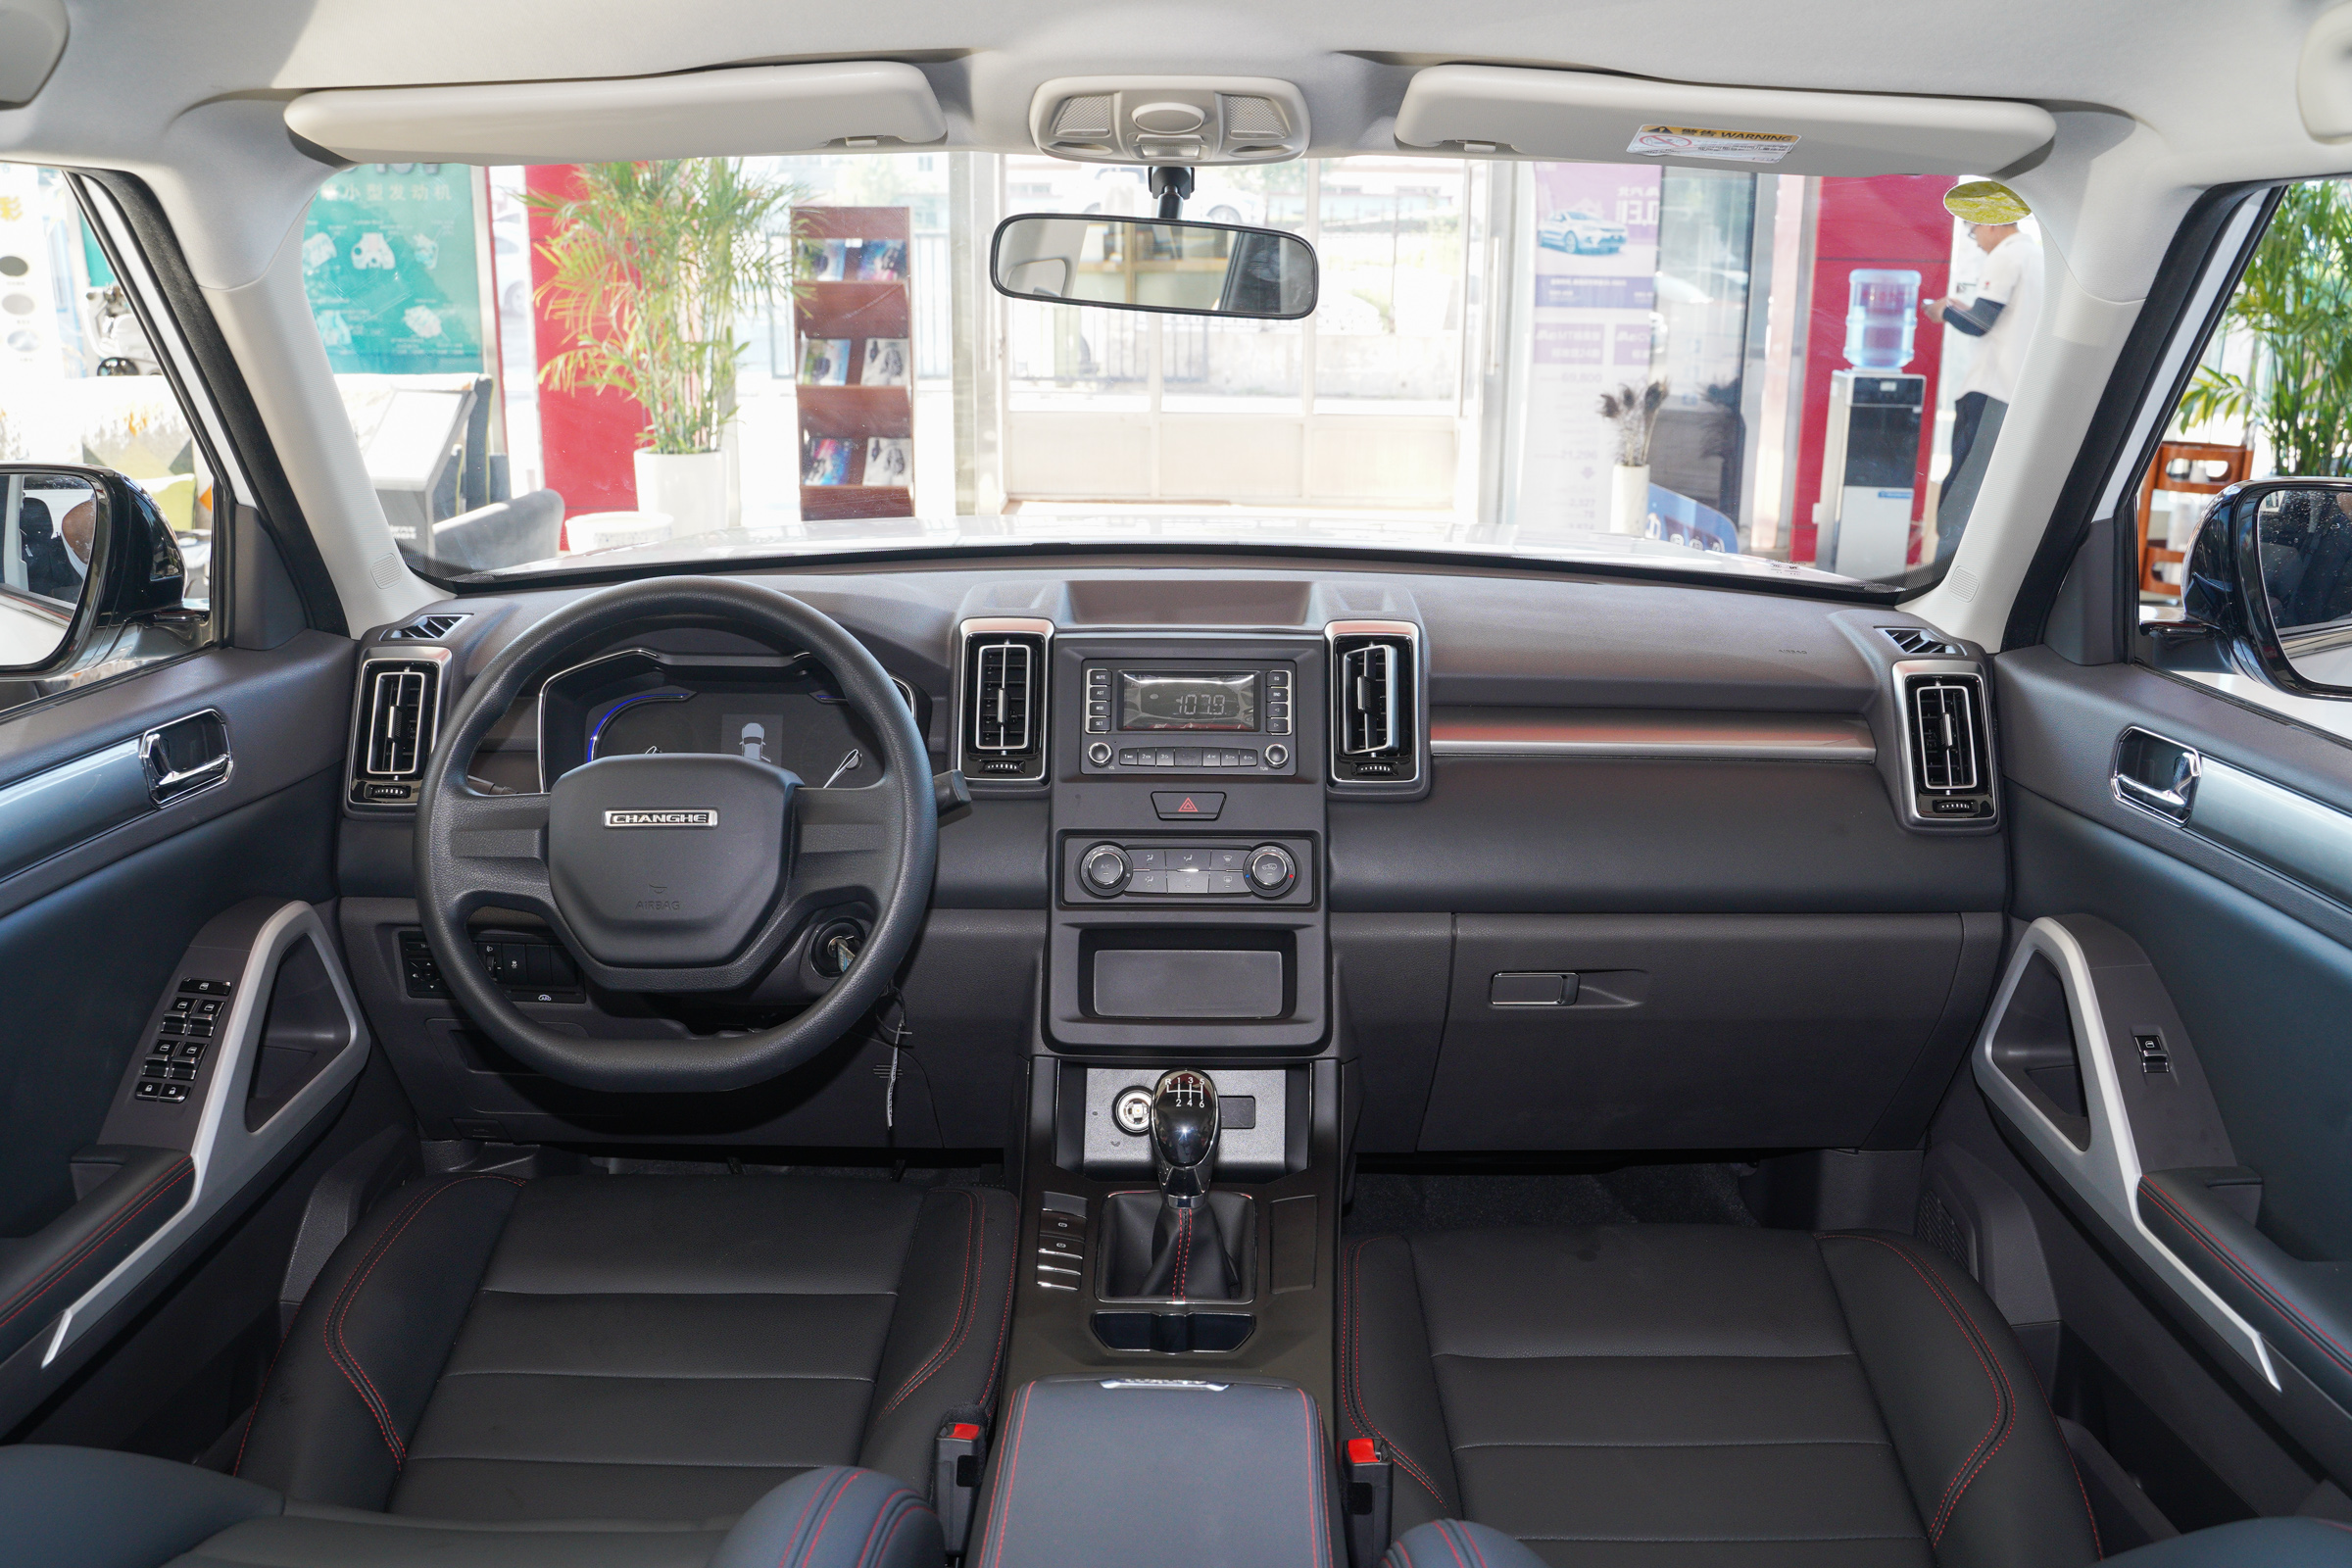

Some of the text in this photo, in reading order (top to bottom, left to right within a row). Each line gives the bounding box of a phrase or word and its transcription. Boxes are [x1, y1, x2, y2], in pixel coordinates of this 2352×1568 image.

[1681, 128, 1793, 142] 警告 WARNING
[612, 813, 708, 823] CHANGHE
[635, 901, 680, 910] AIRBAG
[1175, 1099, 1182, 1107] 2
[1199, 1100, 1205, 1108] 6
